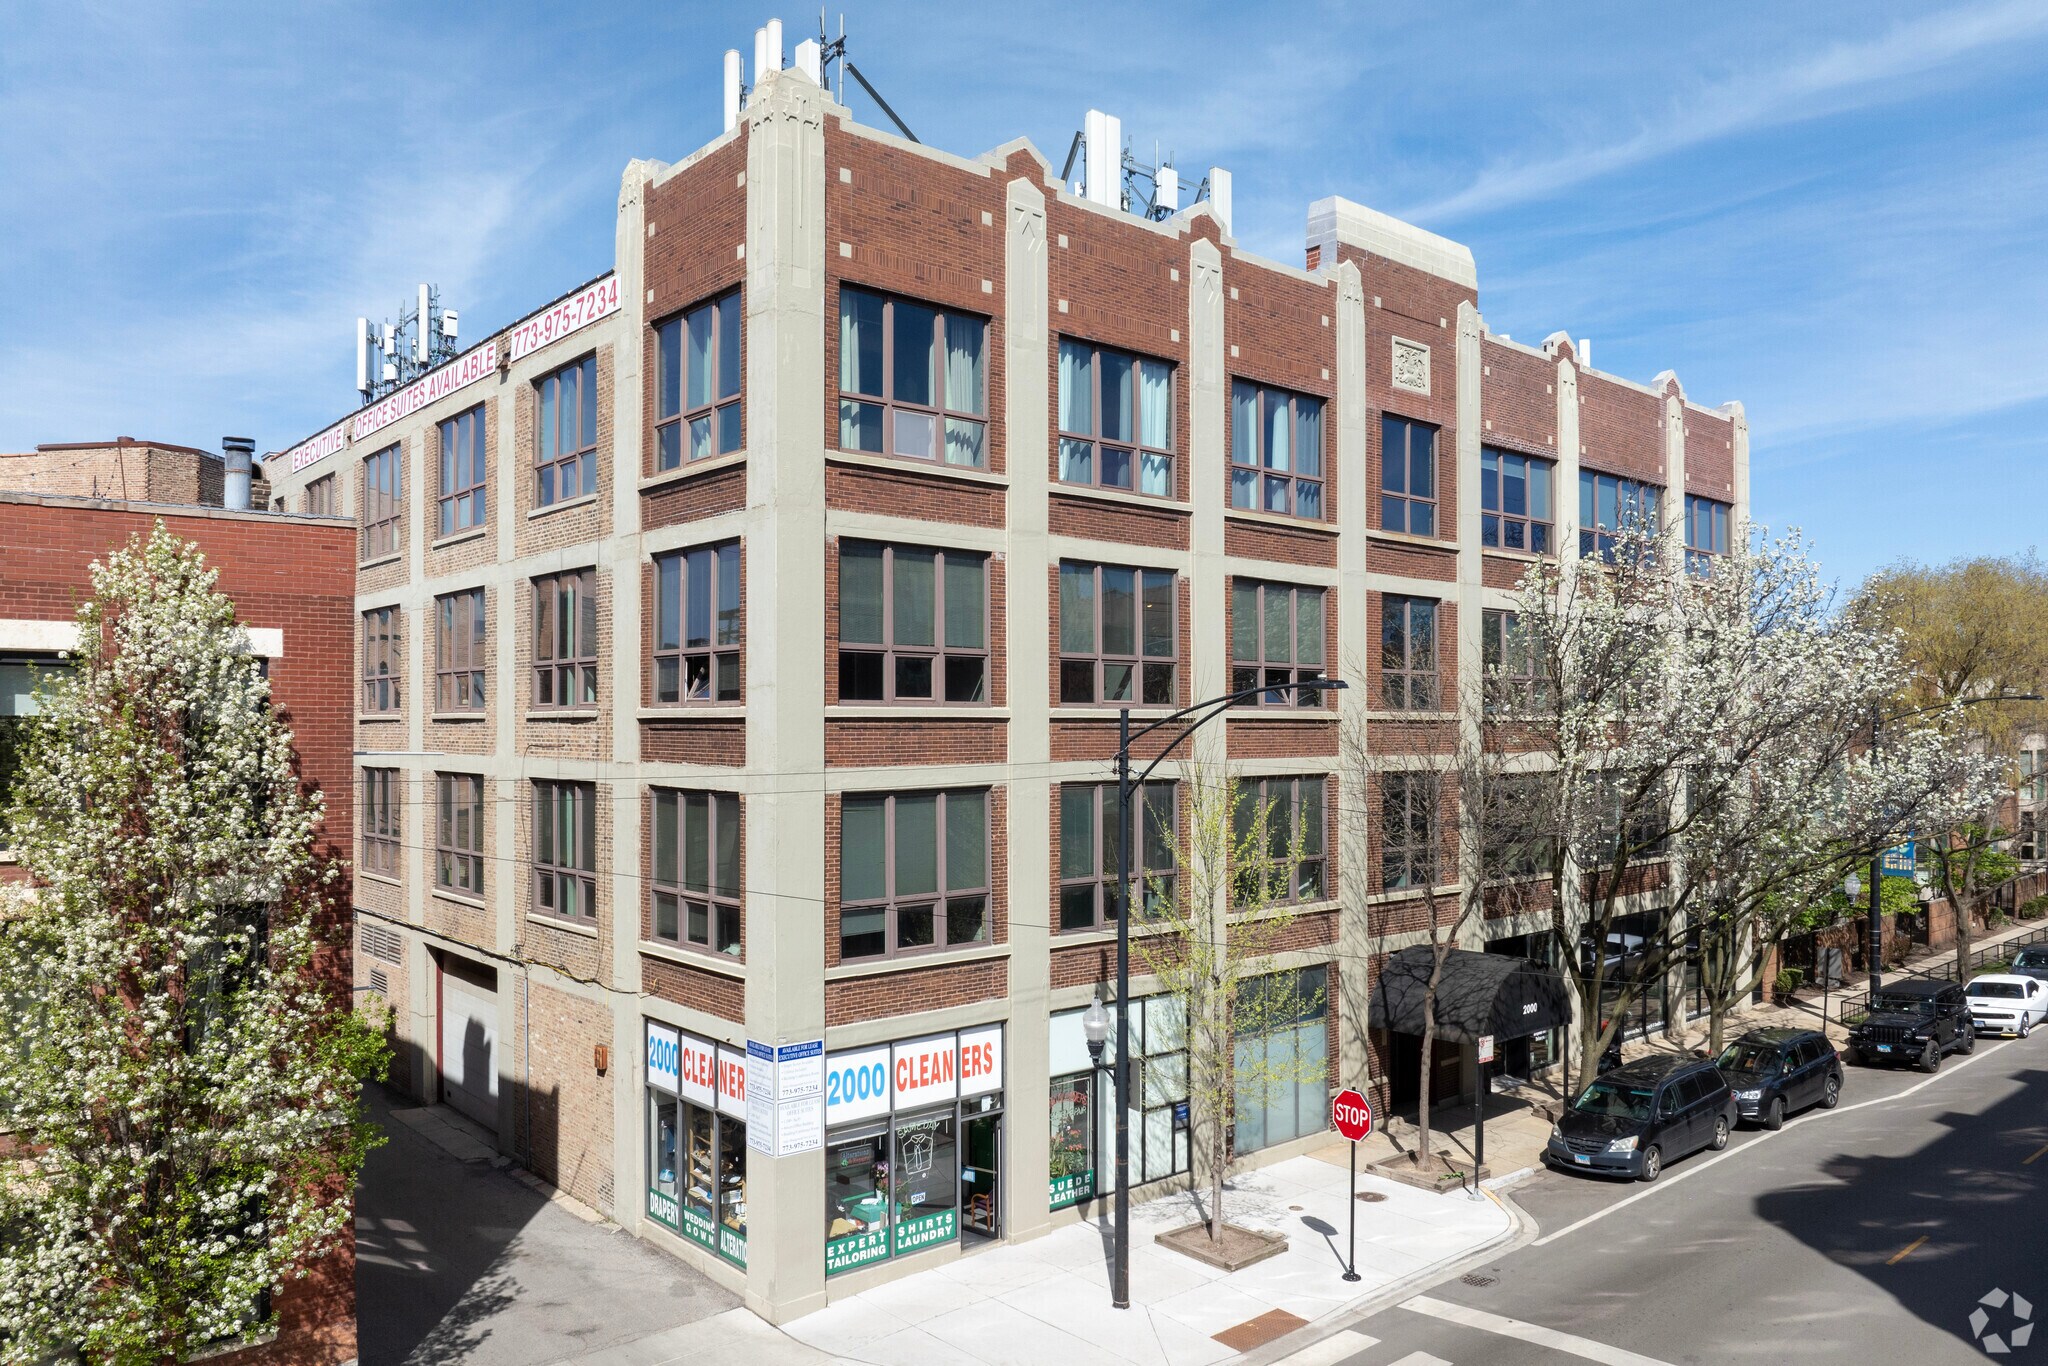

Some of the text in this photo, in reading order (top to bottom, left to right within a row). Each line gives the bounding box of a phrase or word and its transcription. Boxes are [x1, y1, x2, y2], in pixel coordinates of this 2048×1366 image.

[514, 279, 618, 356] 773-975-7234
[355, 345, 495, 438] OFFICE SUITES AVAILABLE
[293, 427, 342, 470] EXECUTIVE
[1523, 1002, 1538, 1015] 2000
[649, 1035, 678, 1077] 2000
[782, 1085, 818, 1096] 773-975-7234
[827, 1062, 885, 1106] 2000
[1335, 1103, 1368, 1127] STOP
[782, 1139, 818, 1152] 773-975-7234
[1049, 1173, 1091, 1193] SUEDE
[1049, 1185, 1090, 1204] LEATHER
[649, 1191, 679, 1226] DRAPERY
[912, 1193, 925, 1203] OPEN
[686, 1223, 714, 1246] GOWN
[898, 1213, 953, 1237] SHIRTS
[898, 1225, 952, 1249] LAUNDRY
[827, 1229, 886, 1258] EXPERT
[827, 1245, 886, 1269] TAILORING
